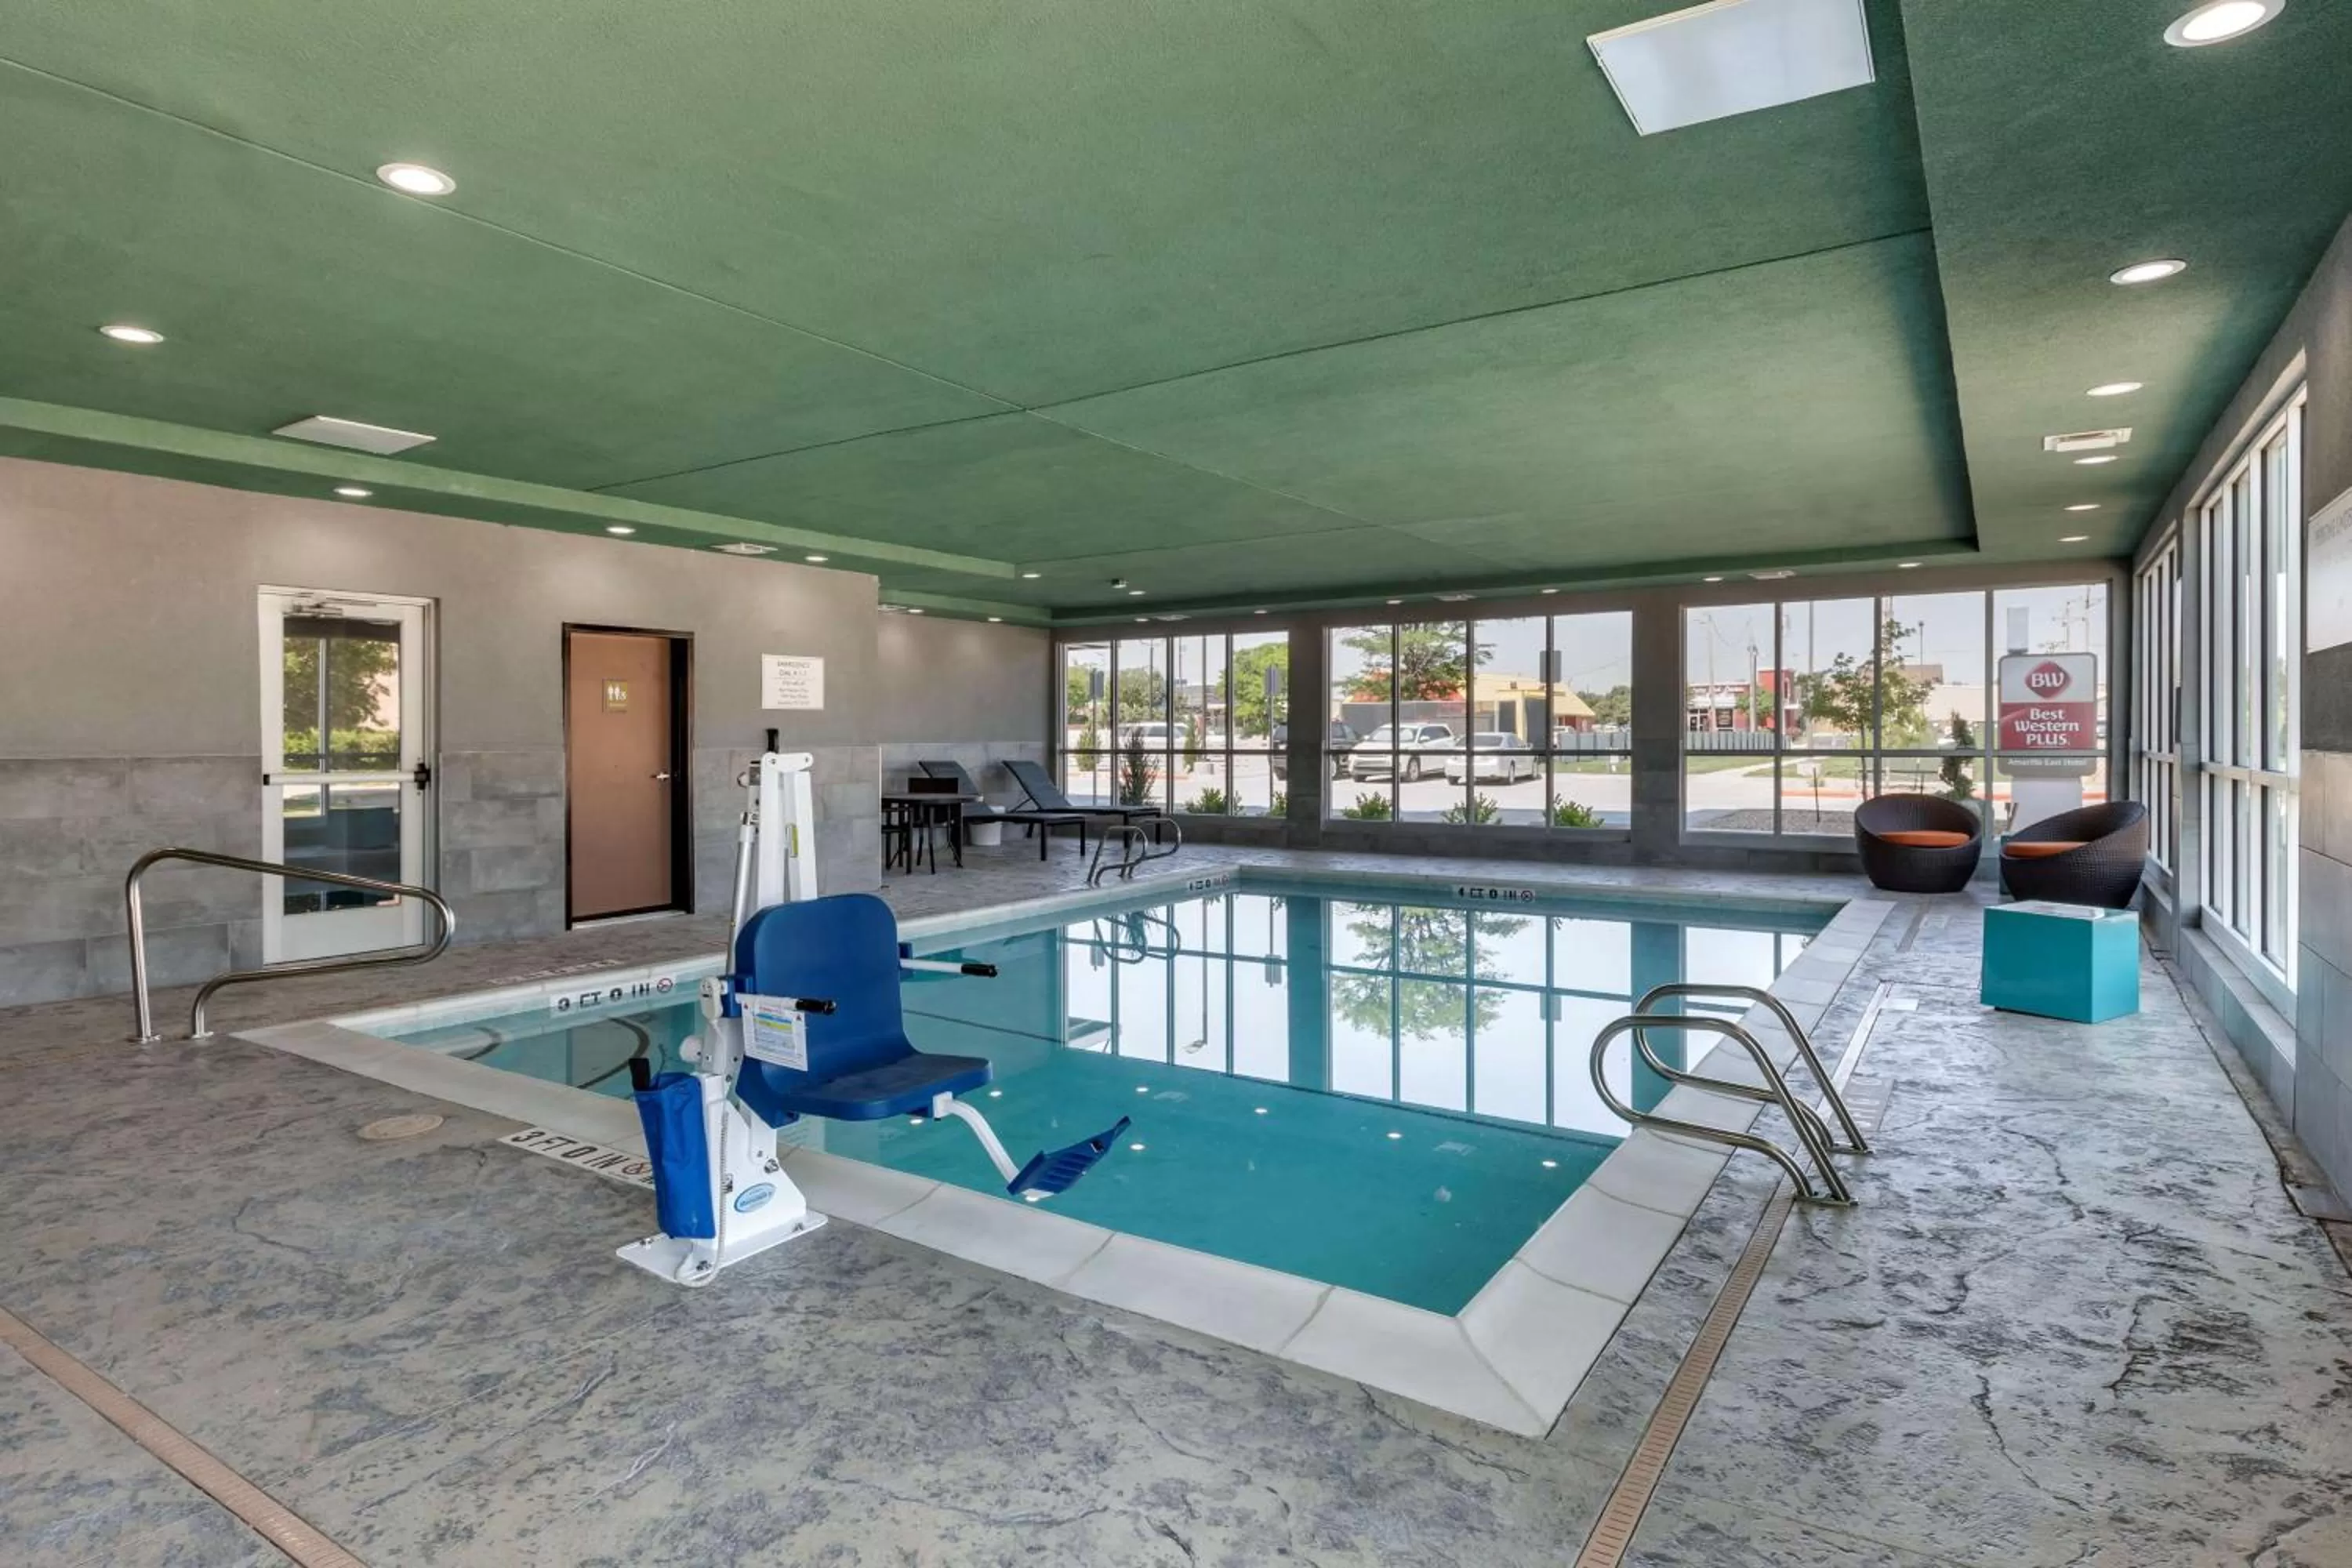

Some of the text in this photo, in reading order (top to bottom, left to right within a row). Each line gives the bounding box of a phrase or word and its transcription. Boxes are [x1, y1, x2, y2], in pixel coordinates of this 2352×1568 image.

[2031, 672, 2065, 688] BW
[2030, 708, 2066, 720] Best
[2014, 720, 2080, 732] Western
[2026, 733, 2068, 746] PLUS
[510, 1131, 546, 1142] 3
[528, 1136, 579, 1152] FT
[583, 1152, 630, 1169] IN
